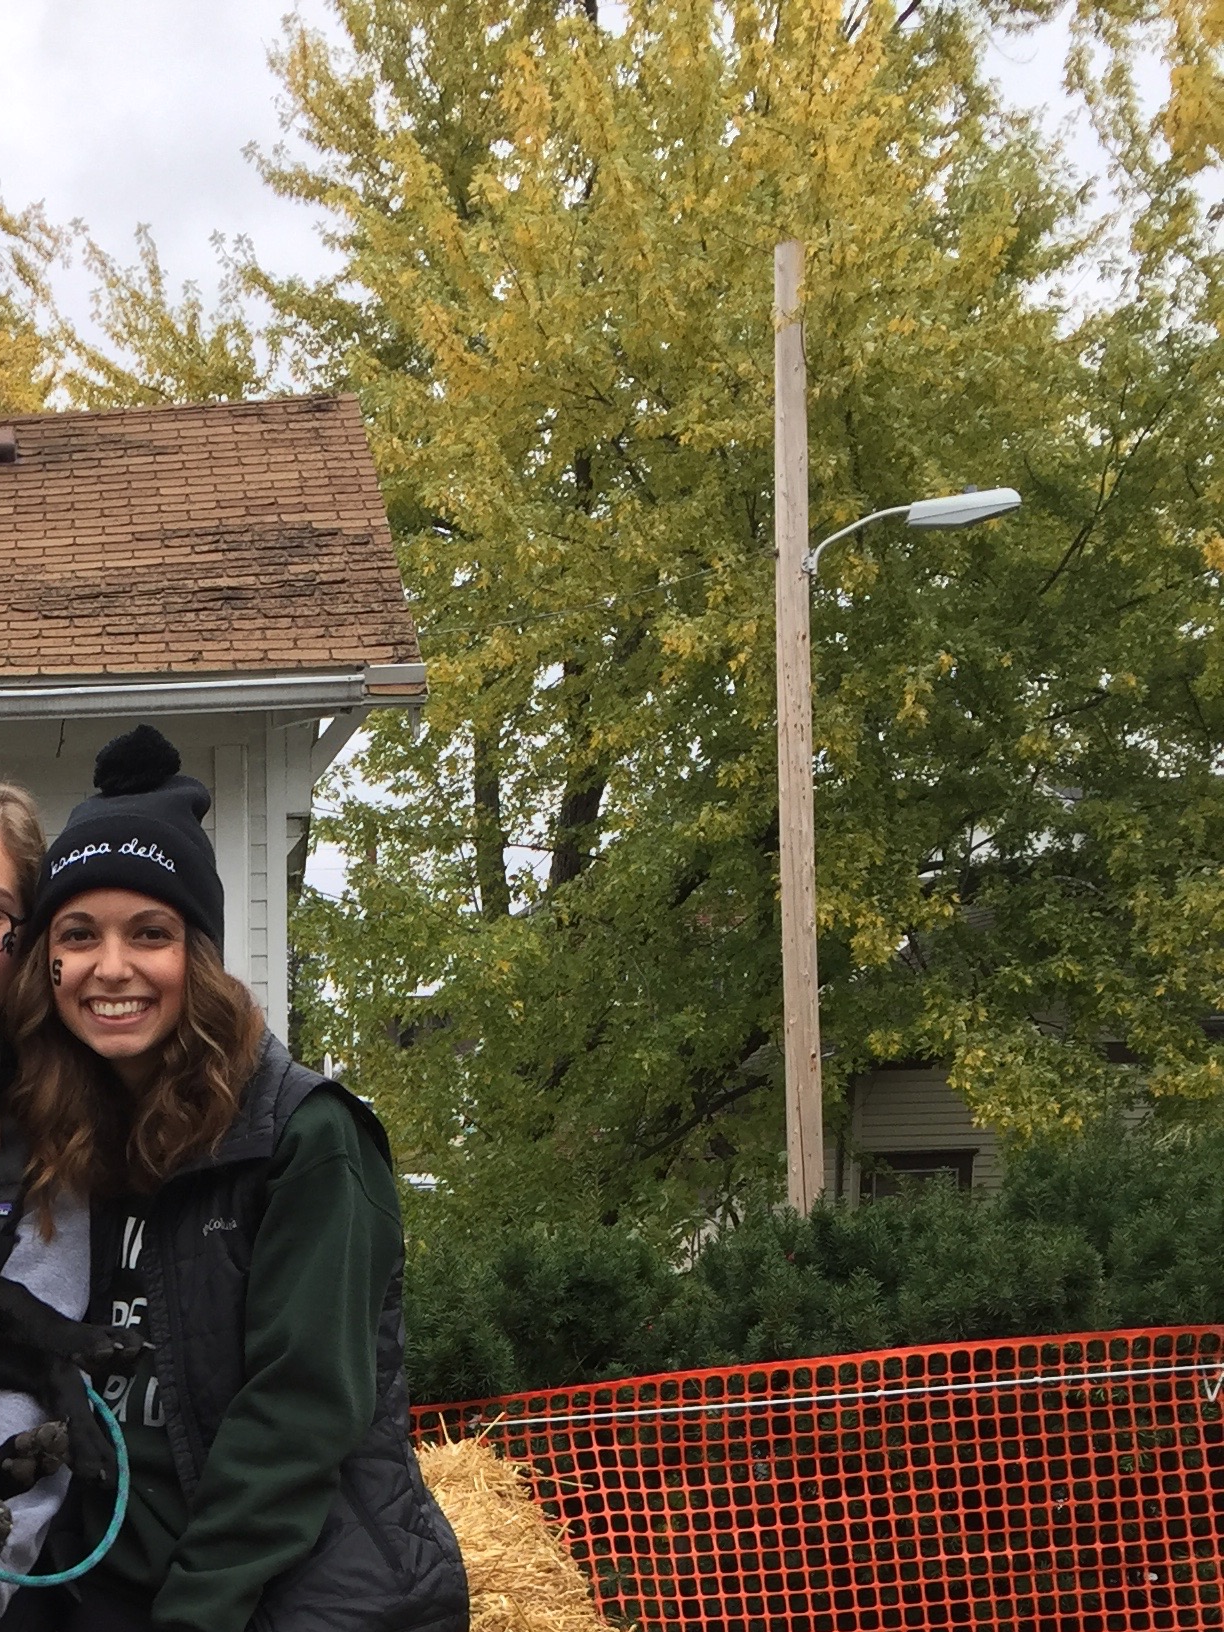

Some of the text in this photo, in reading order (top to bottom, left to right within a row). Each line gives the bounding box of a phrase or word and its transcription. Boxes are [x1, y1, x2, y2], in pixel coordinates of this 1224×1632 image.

[50, 837, 176, 880] kappa delta
[52, 958, 63, 987] S
